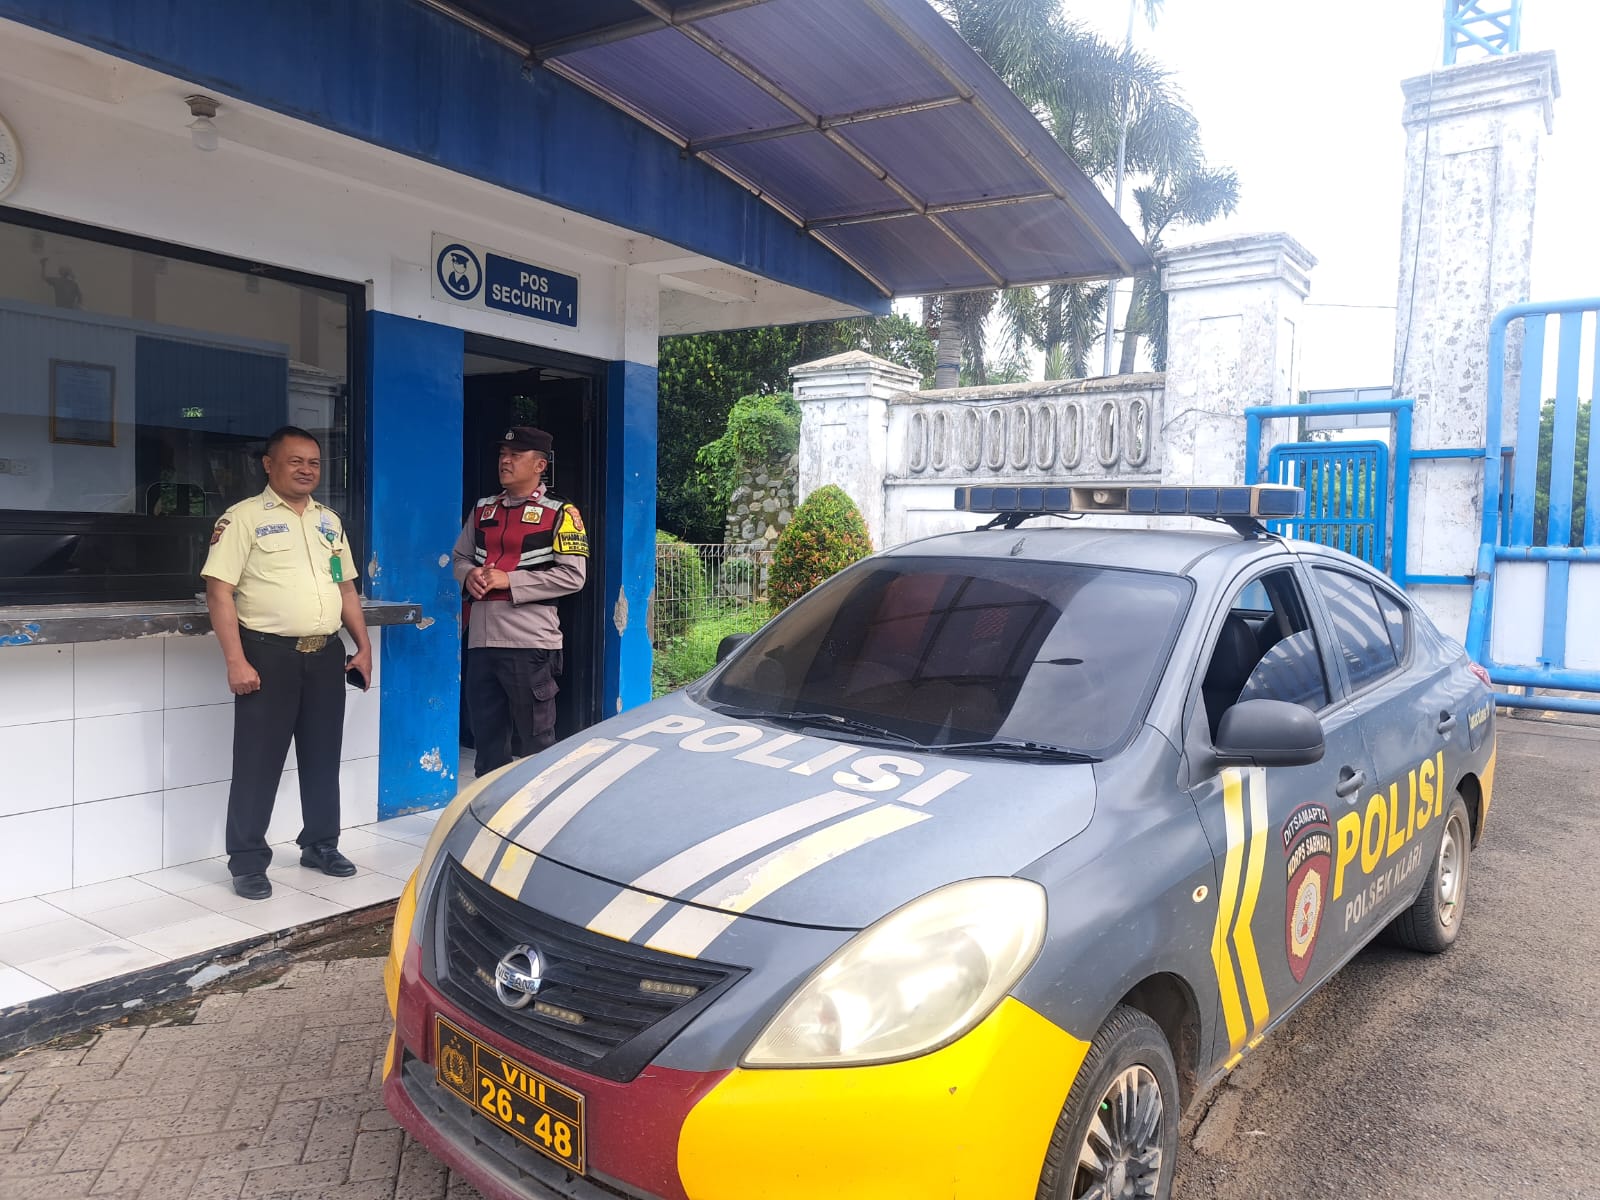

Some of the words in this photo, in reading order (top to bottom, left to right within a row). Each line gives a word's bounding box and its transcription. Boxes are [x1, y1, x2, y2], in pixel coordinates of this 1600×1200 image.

[492, 284, 562, 315] SECURITY
[566, 303, 573, 319] 1
[520, 271, 549, 293] POS
[616, 714, 973, 807] POLISI
[1283, 807, 1328, 847] DITSAMAPTA
[1333, 750, 1444, 901] POLISI
[1287, 842, 1306, 882] KORPS
[1344, 868, 1393, 933] POLSEK
[496, 965, 531, 991] NISSAN
[501, 1061, 546, 1104] VIII
